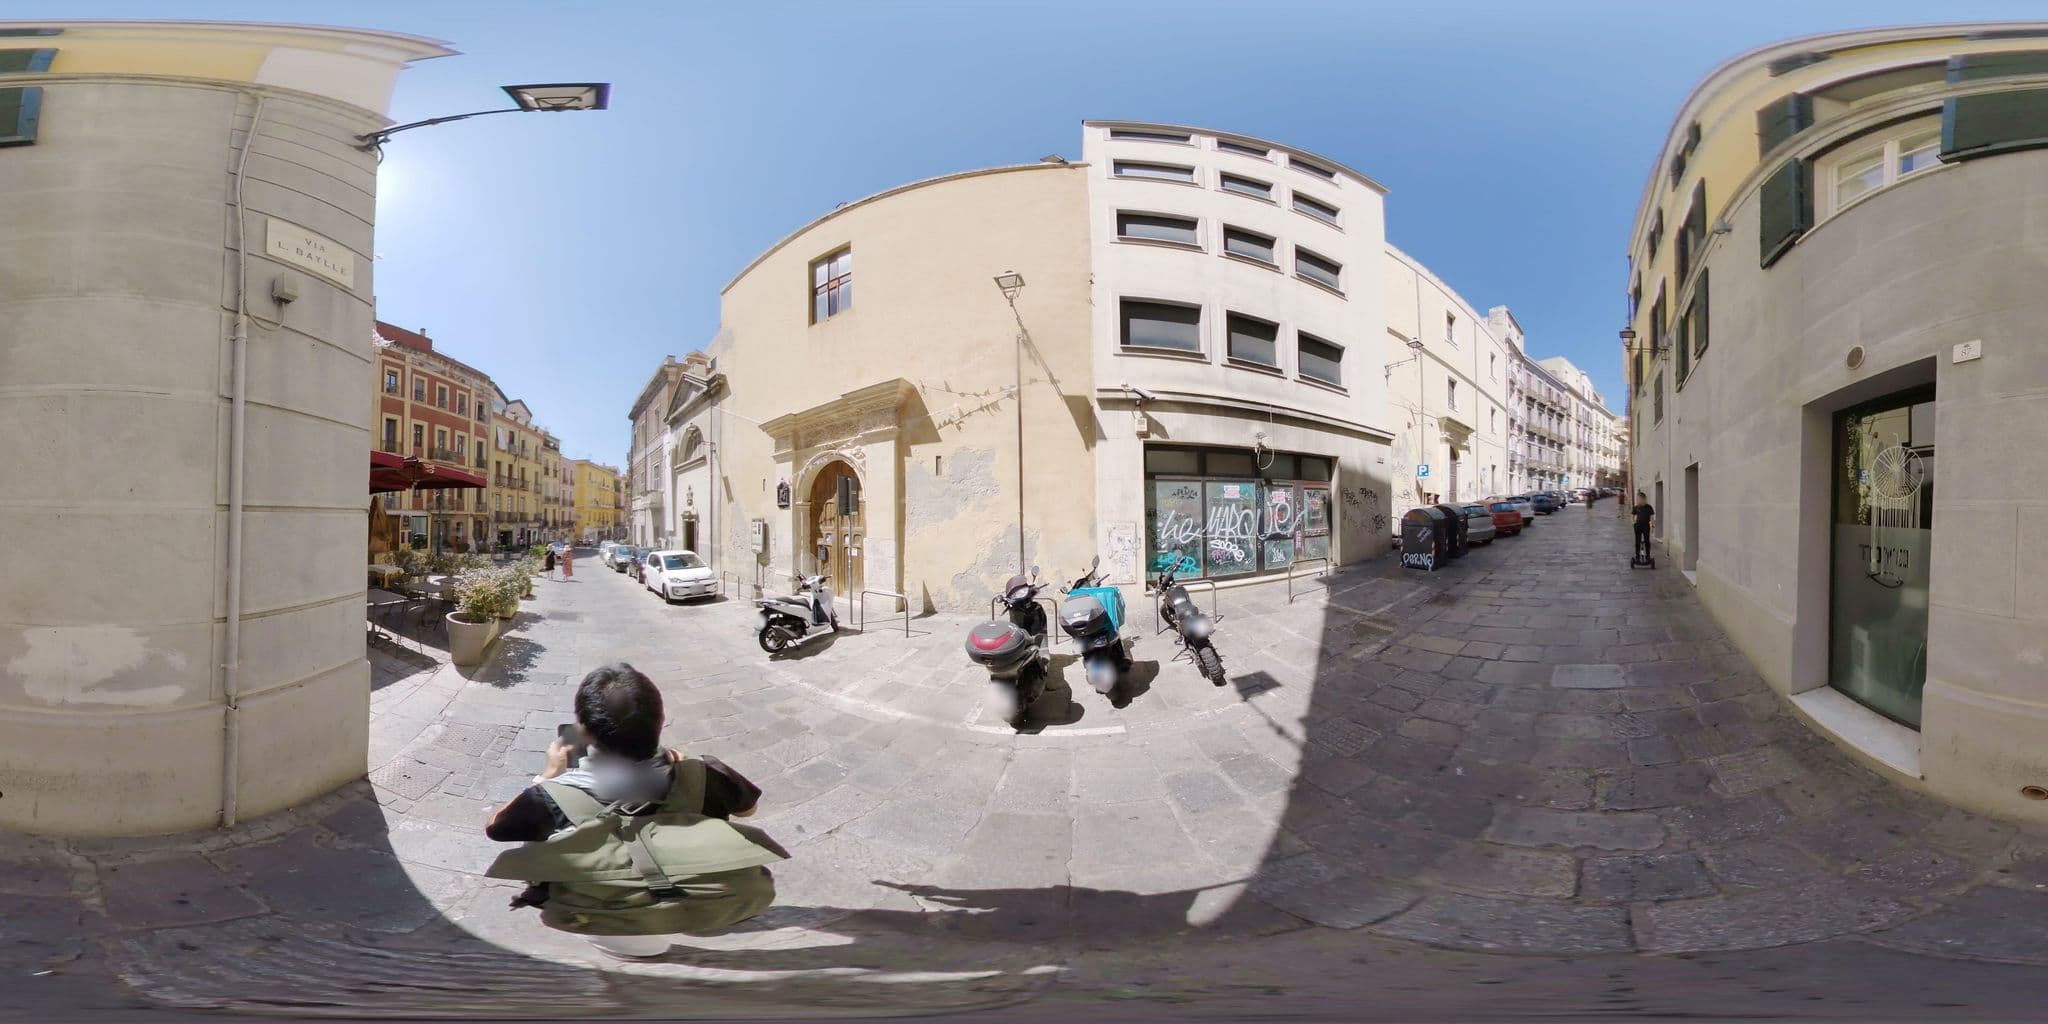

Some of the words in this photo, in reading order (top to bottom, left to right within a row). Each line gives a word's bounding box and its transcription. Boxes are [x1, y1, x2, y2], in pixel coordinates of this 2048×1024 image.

[305, 238, 326, 252] VIA
[278, 241, 289, 251] L.
[295, 247, 346, 274] BAYLLE
